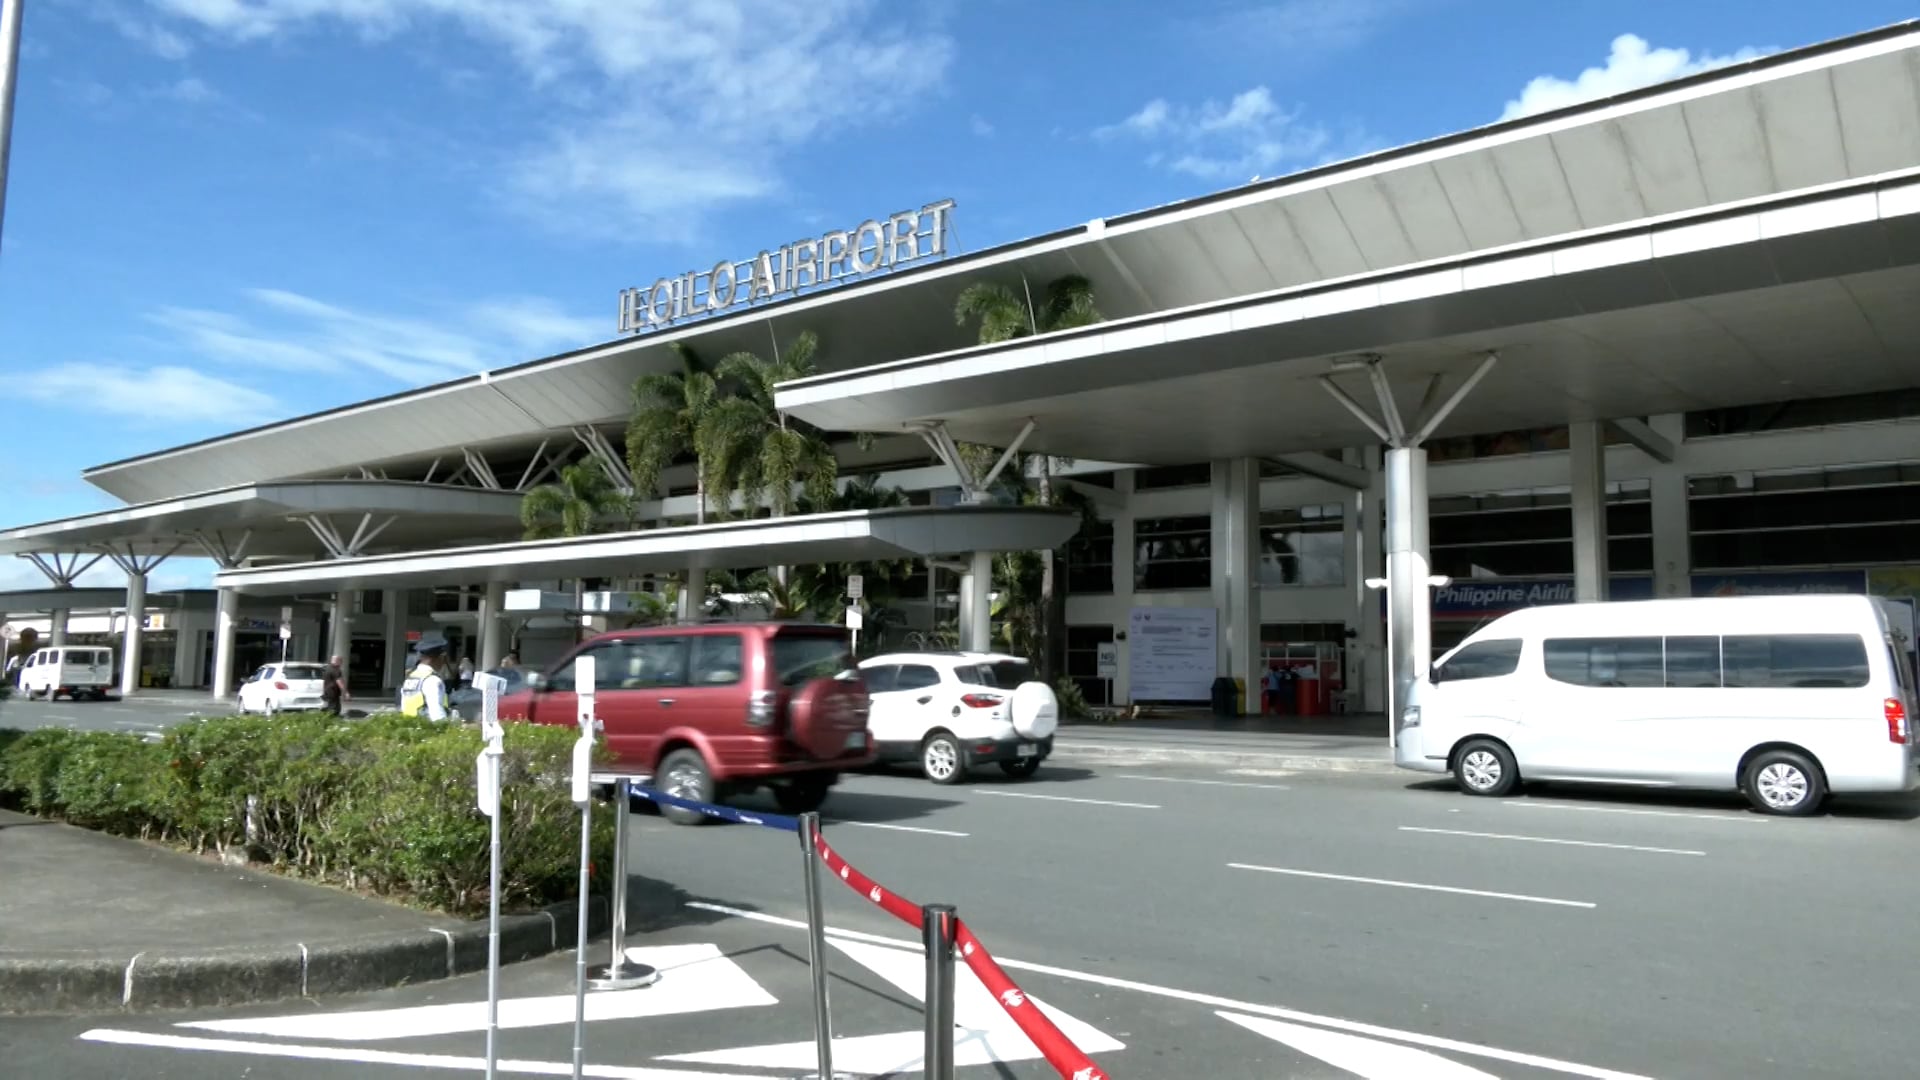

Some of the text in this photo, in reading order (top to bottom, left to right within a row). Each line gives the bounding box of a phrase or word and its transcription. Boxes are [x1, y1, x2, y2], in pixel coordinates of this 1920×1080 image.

[618, 198, 957, 333] ILOILO AIRPORT
[1435, 584, 1576, 606] Philippine Airlin
